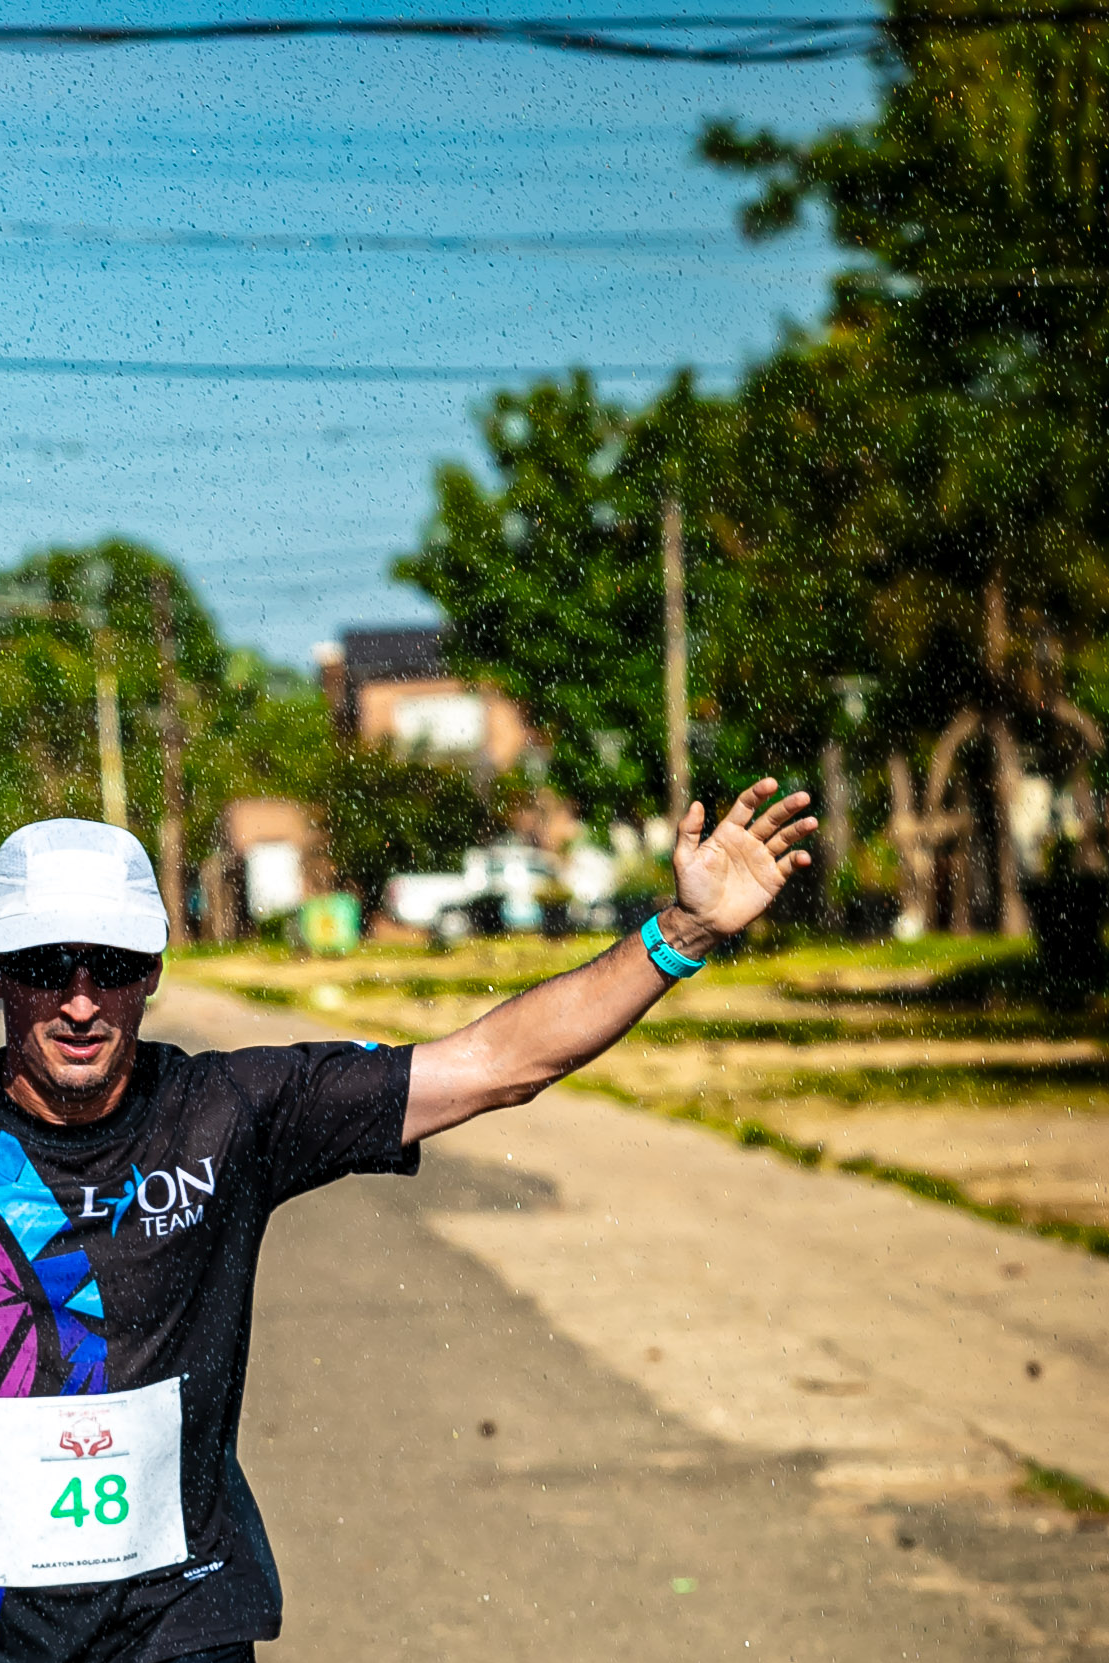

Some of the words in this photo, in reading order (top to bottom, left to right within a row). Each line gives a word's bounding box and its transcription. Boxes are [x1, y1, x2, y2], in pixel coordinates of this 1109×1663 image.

[139, 1204, 204, 1238] TEAM
[49, 1473, 130, 1528] 48
[76, 1556, 121, 1566] SOLIDARIA
